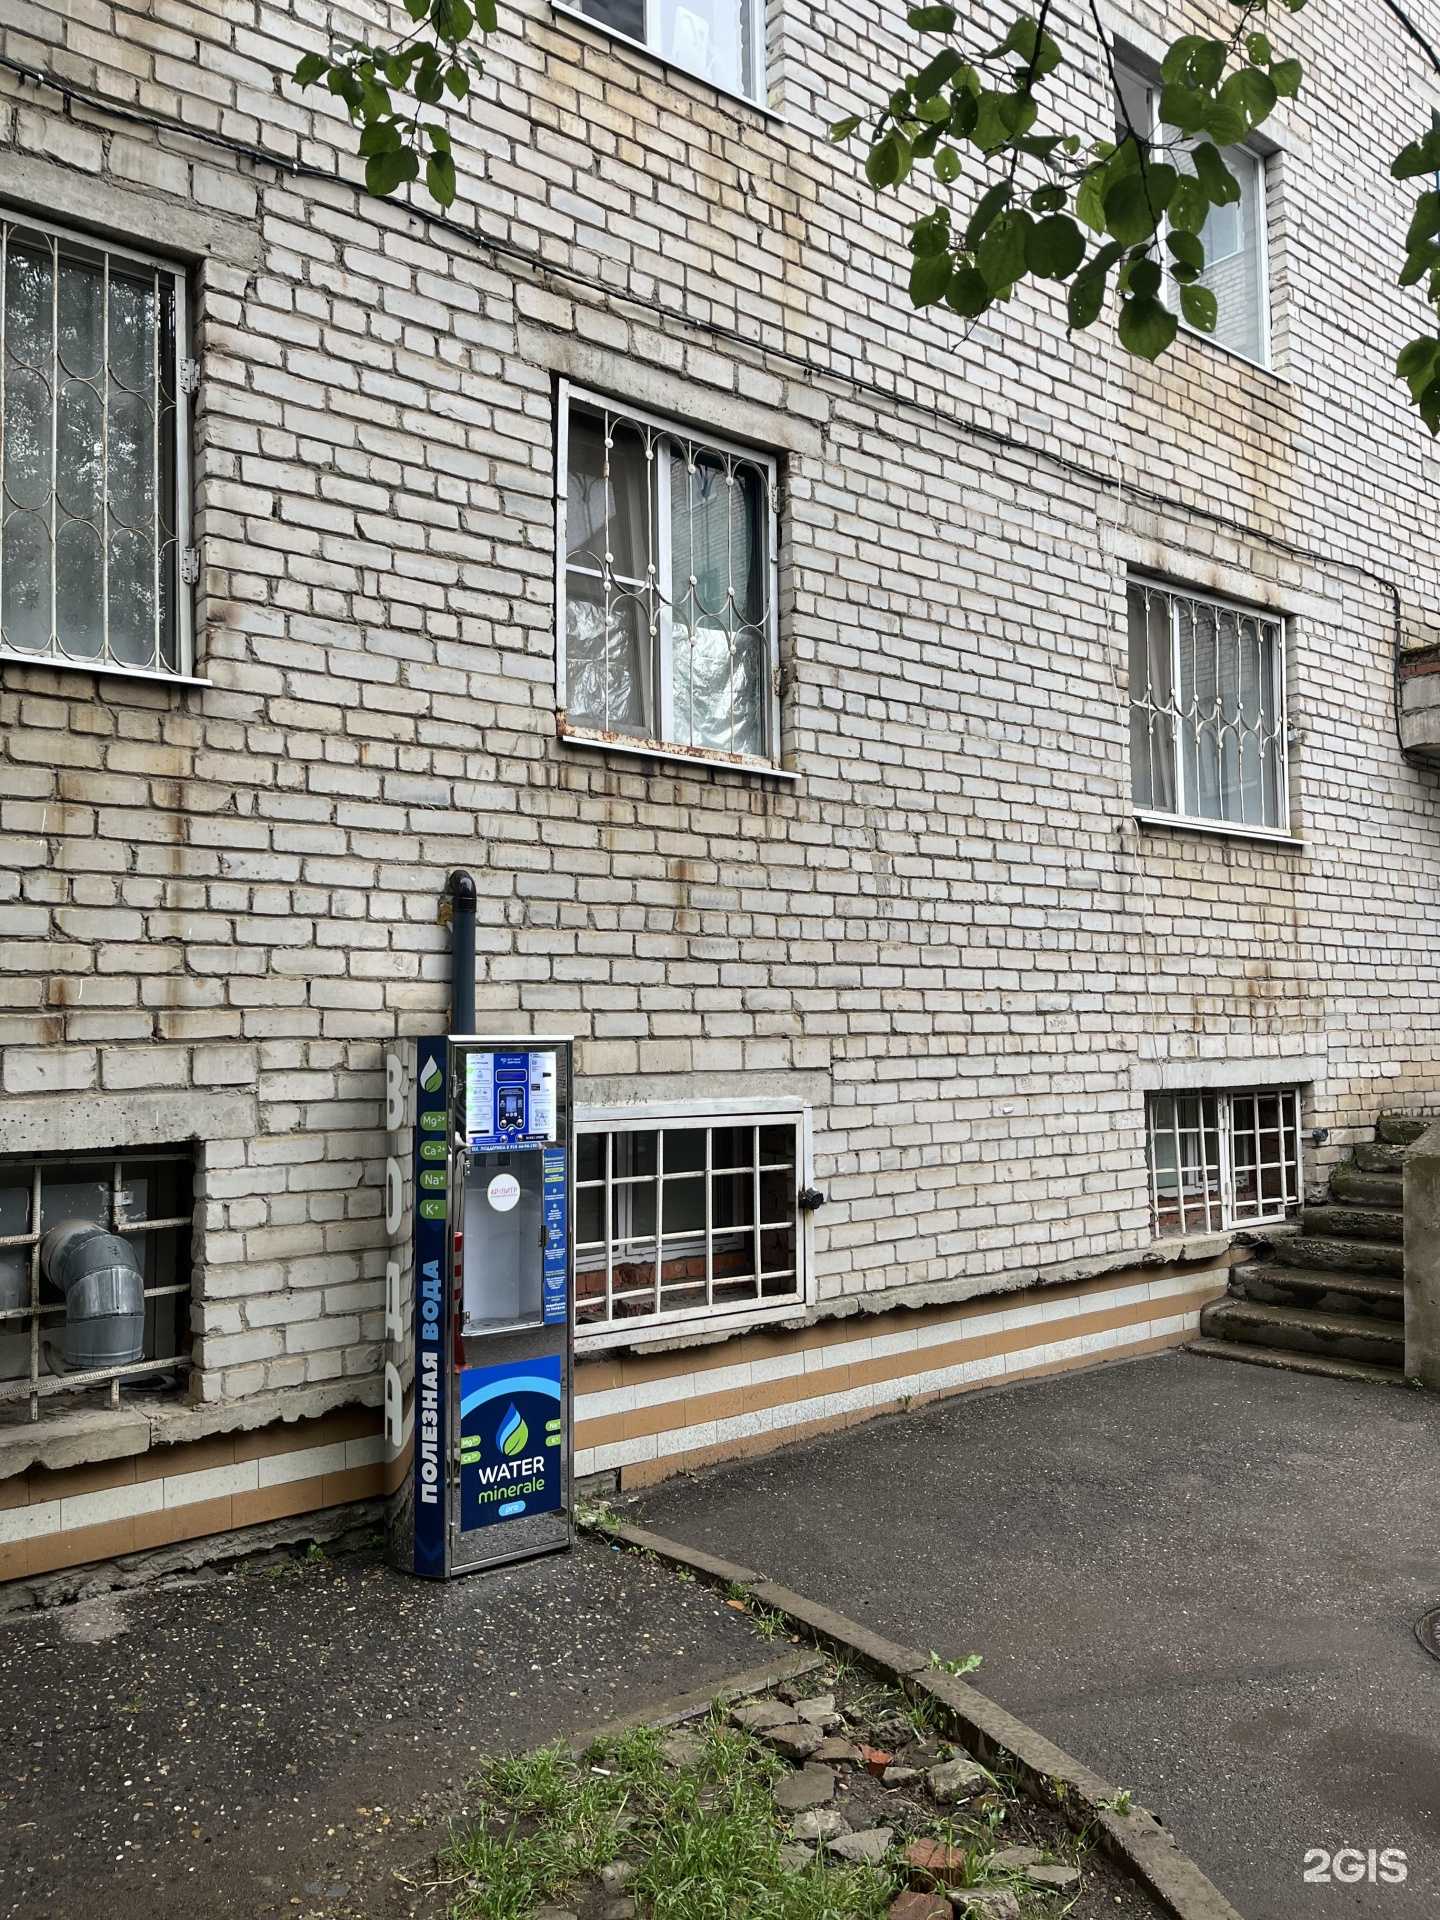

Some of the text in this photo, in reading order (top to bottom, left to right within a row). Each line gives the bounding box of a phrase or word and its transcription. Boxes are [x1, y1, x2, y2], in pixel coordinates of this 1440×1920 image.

[421, 1259, 442, 1504] ПОЛЕЗНАЯ ВОДА
[478, 1455, 545, 1485] WATER
[478, 1476, 545, 1505] minerale
